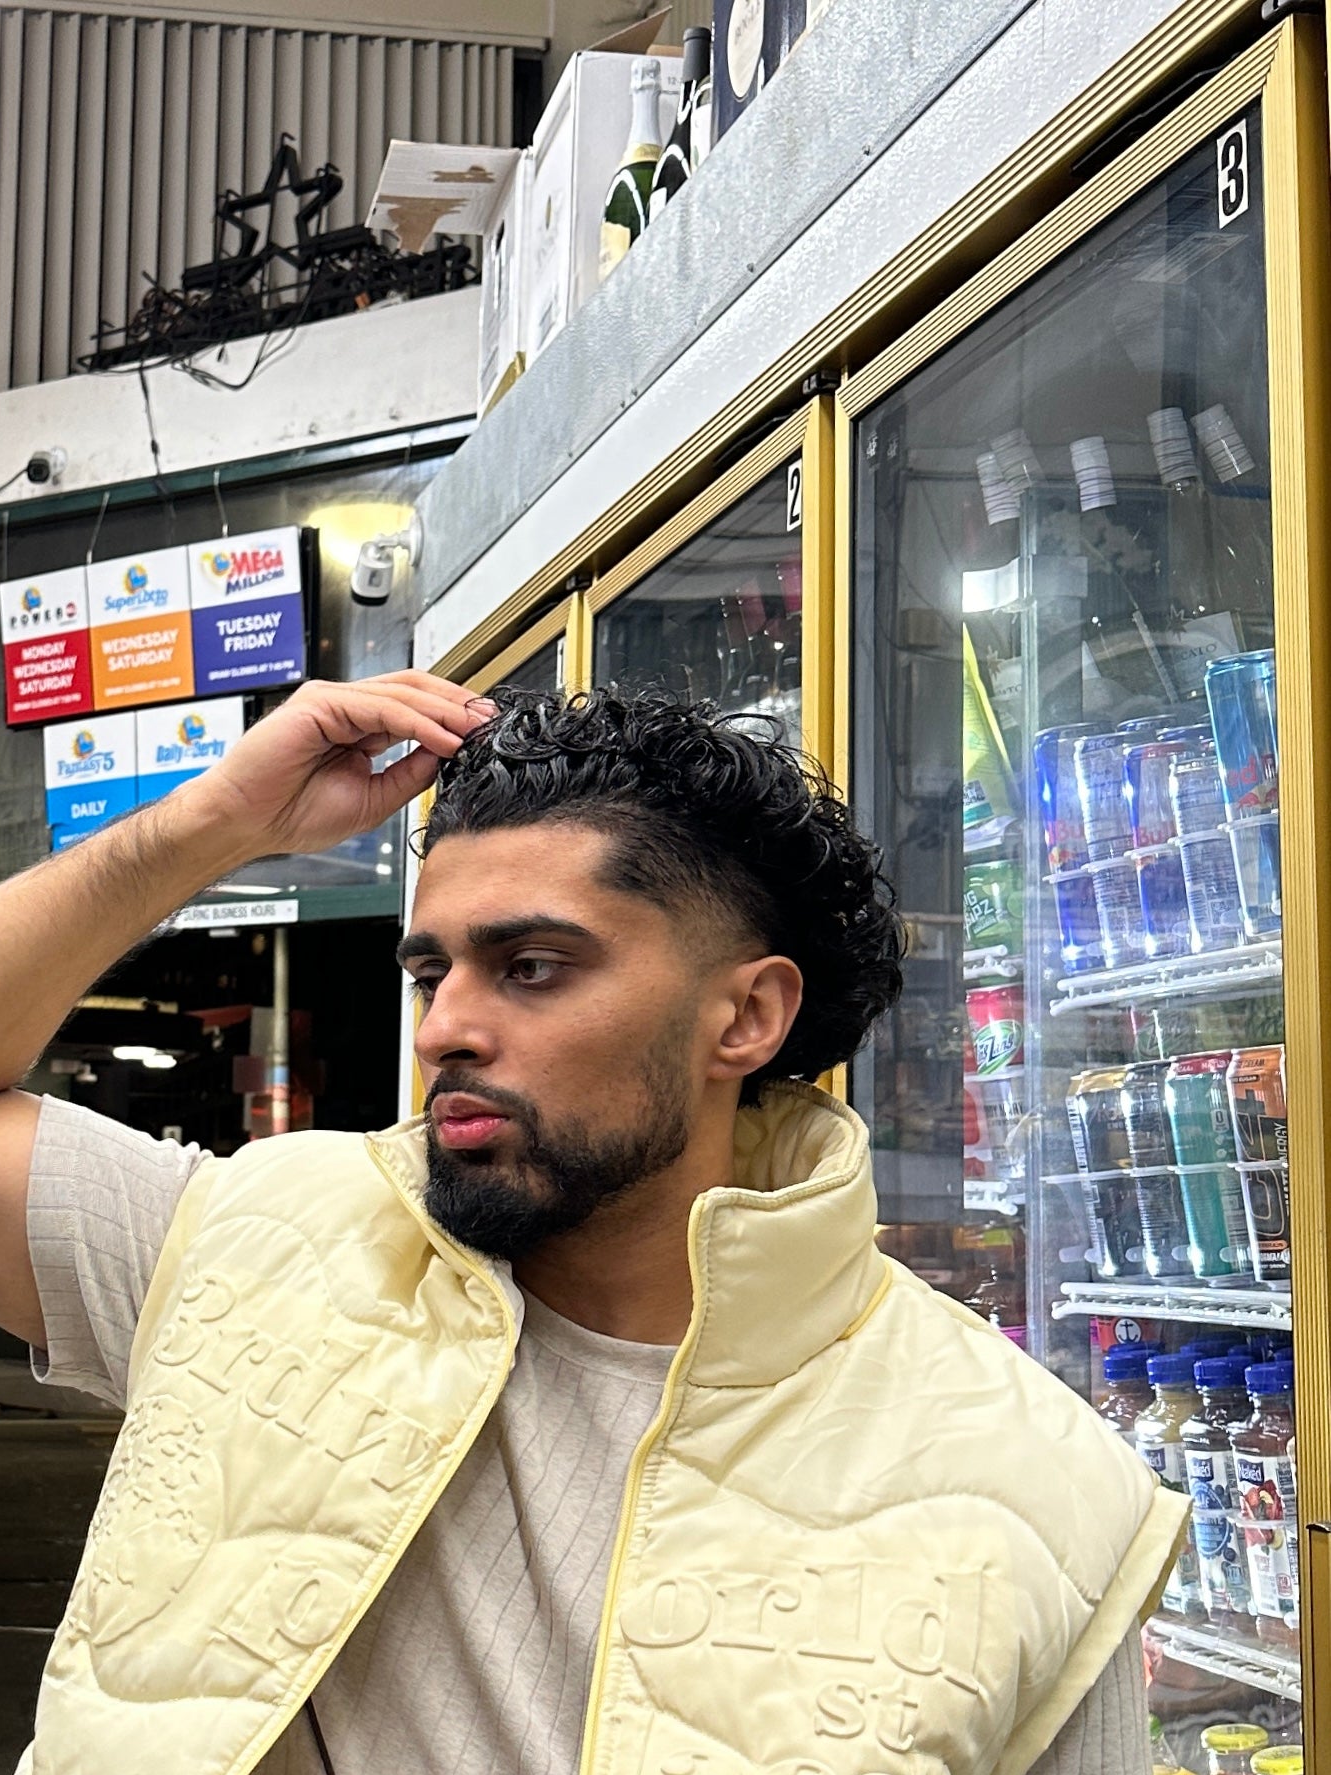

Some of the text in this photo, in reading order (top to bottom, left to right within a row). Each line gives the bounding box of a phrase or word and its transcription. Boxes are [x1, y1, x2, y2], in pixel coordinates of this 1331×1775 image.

[1221, 131, 1245, 217] 3
[790, 467, 801, 526] 2
[229, 550, 284, 579] MEGA
[225, 569, 285, 596] MILLIONS
[216, 611, 282, 636] TUESDAY
[21, 641, 67, 661] MONDAY
[101, 629, 180, 655] WEDNESDAY
[224, 631, 276, 653] FRIDAY
[13, 656, 77, 680] WEDNESDAY
[107, 648, 174, 672] SATURDAY
[19, 674, 74, 695] SATURDAY
[157, 744, 183, 763] Daily
[71, 801, 107, 819] DAILY
[212, 905, 247, 920] BUSINESS
[250, 904, 276, 917] HOURS
